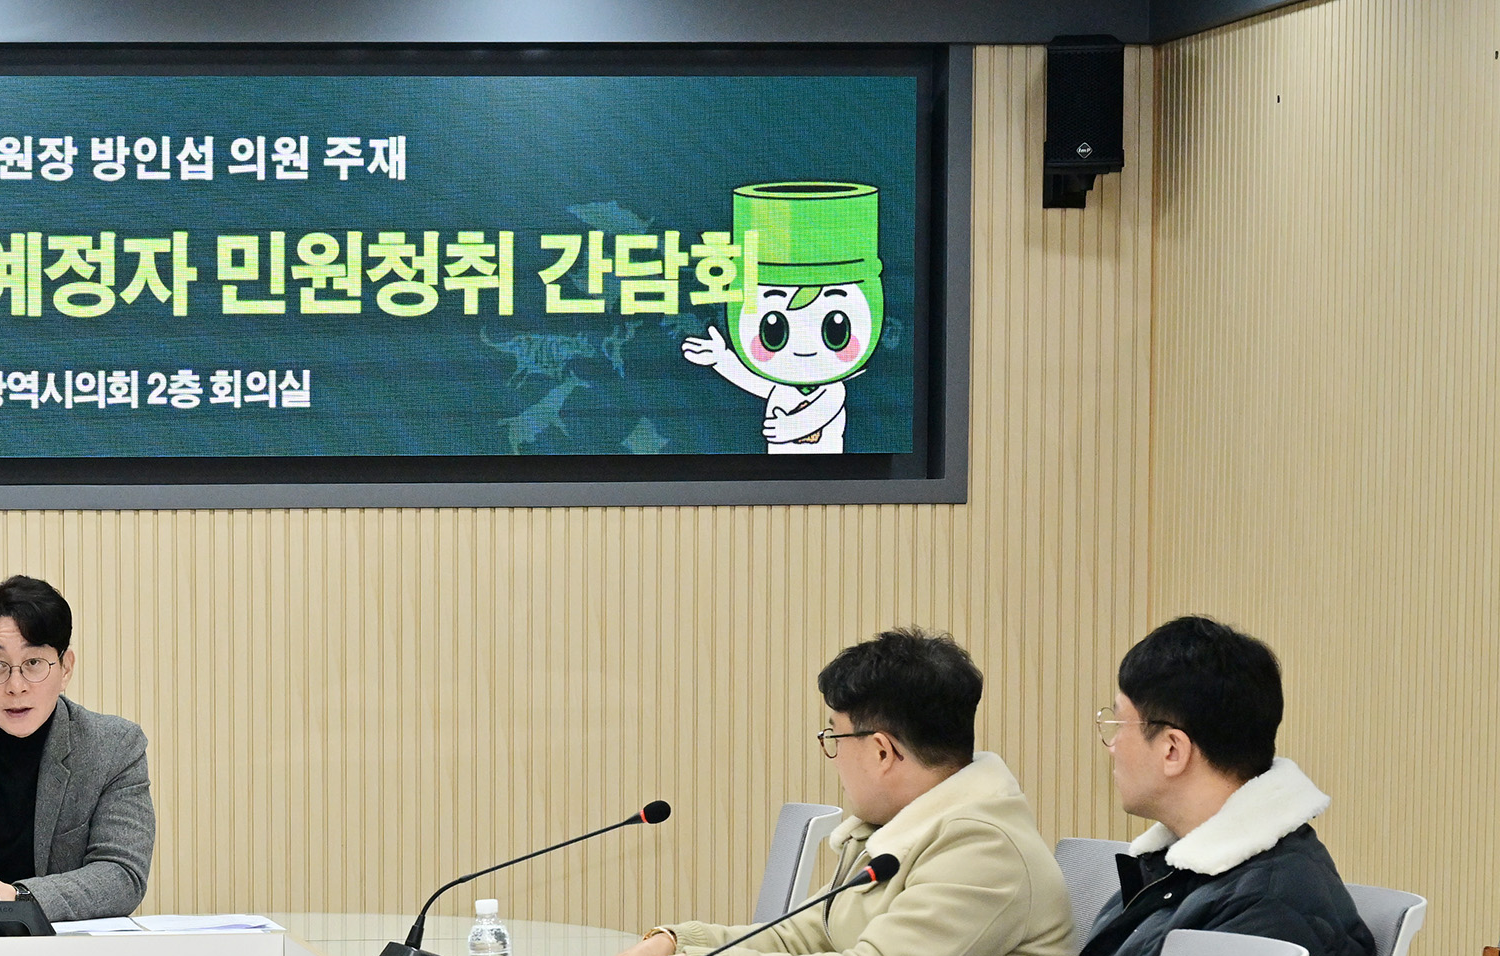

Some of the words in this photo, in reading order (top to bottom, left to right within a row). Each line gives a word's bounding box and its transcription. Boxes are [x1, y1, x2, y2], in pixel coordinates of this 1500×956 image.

[91, 135, 214, 182] 방인섭
[228, 135, 309, 181] 의원
[323, 135, 406, 181] 주재
[217, 230, 514, 317] 민원청취
[537, 230, 759, 316] 간담회
[147, 369, 203, 409] 2층
[209, 369, 311, 409] 회의실
